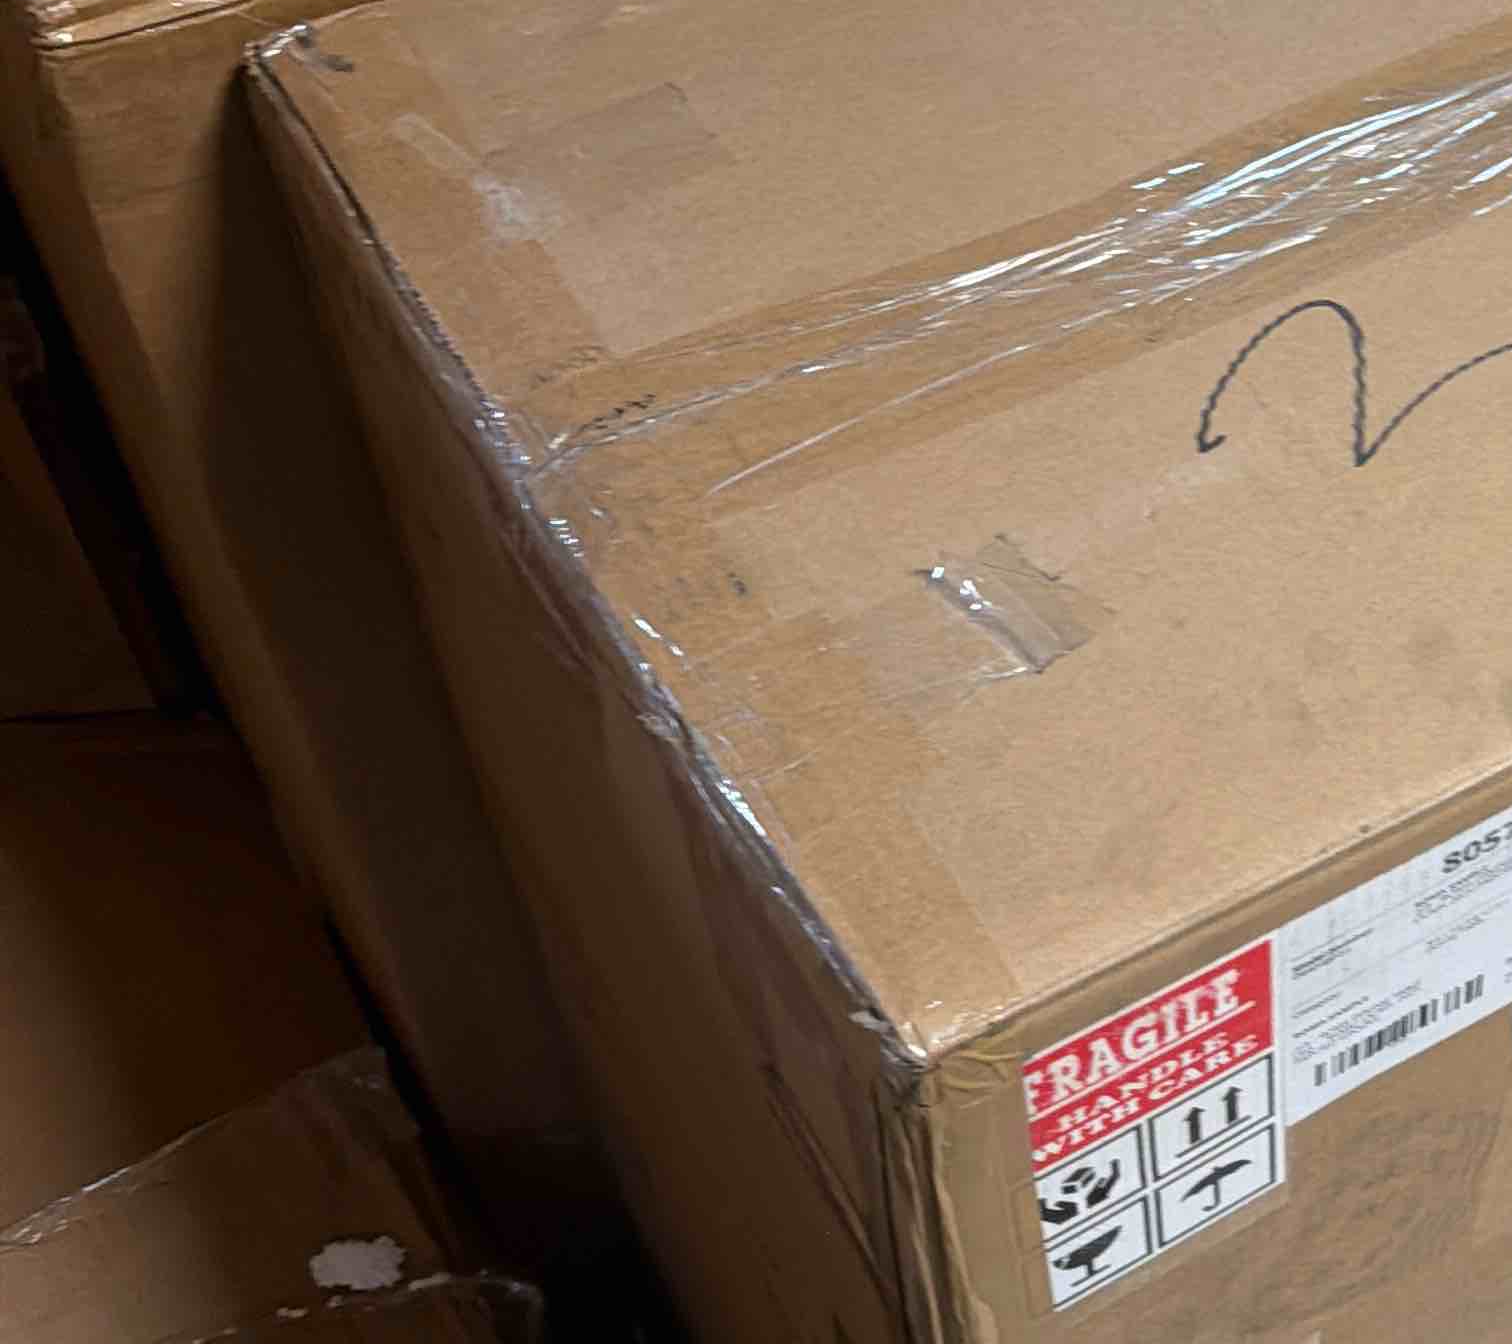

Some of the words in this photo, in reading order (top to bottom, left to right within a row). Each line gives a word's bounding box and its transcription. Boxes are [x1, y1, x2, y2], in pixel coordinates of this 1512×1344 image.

[1023, 968, 1241, 1122] FRAGILE
[1032, 1097, 1142, 1162] WITH
[1149, 1033, 1259, 1102] CARE
[1056, 1031, 1230, 1132] HANDLE
